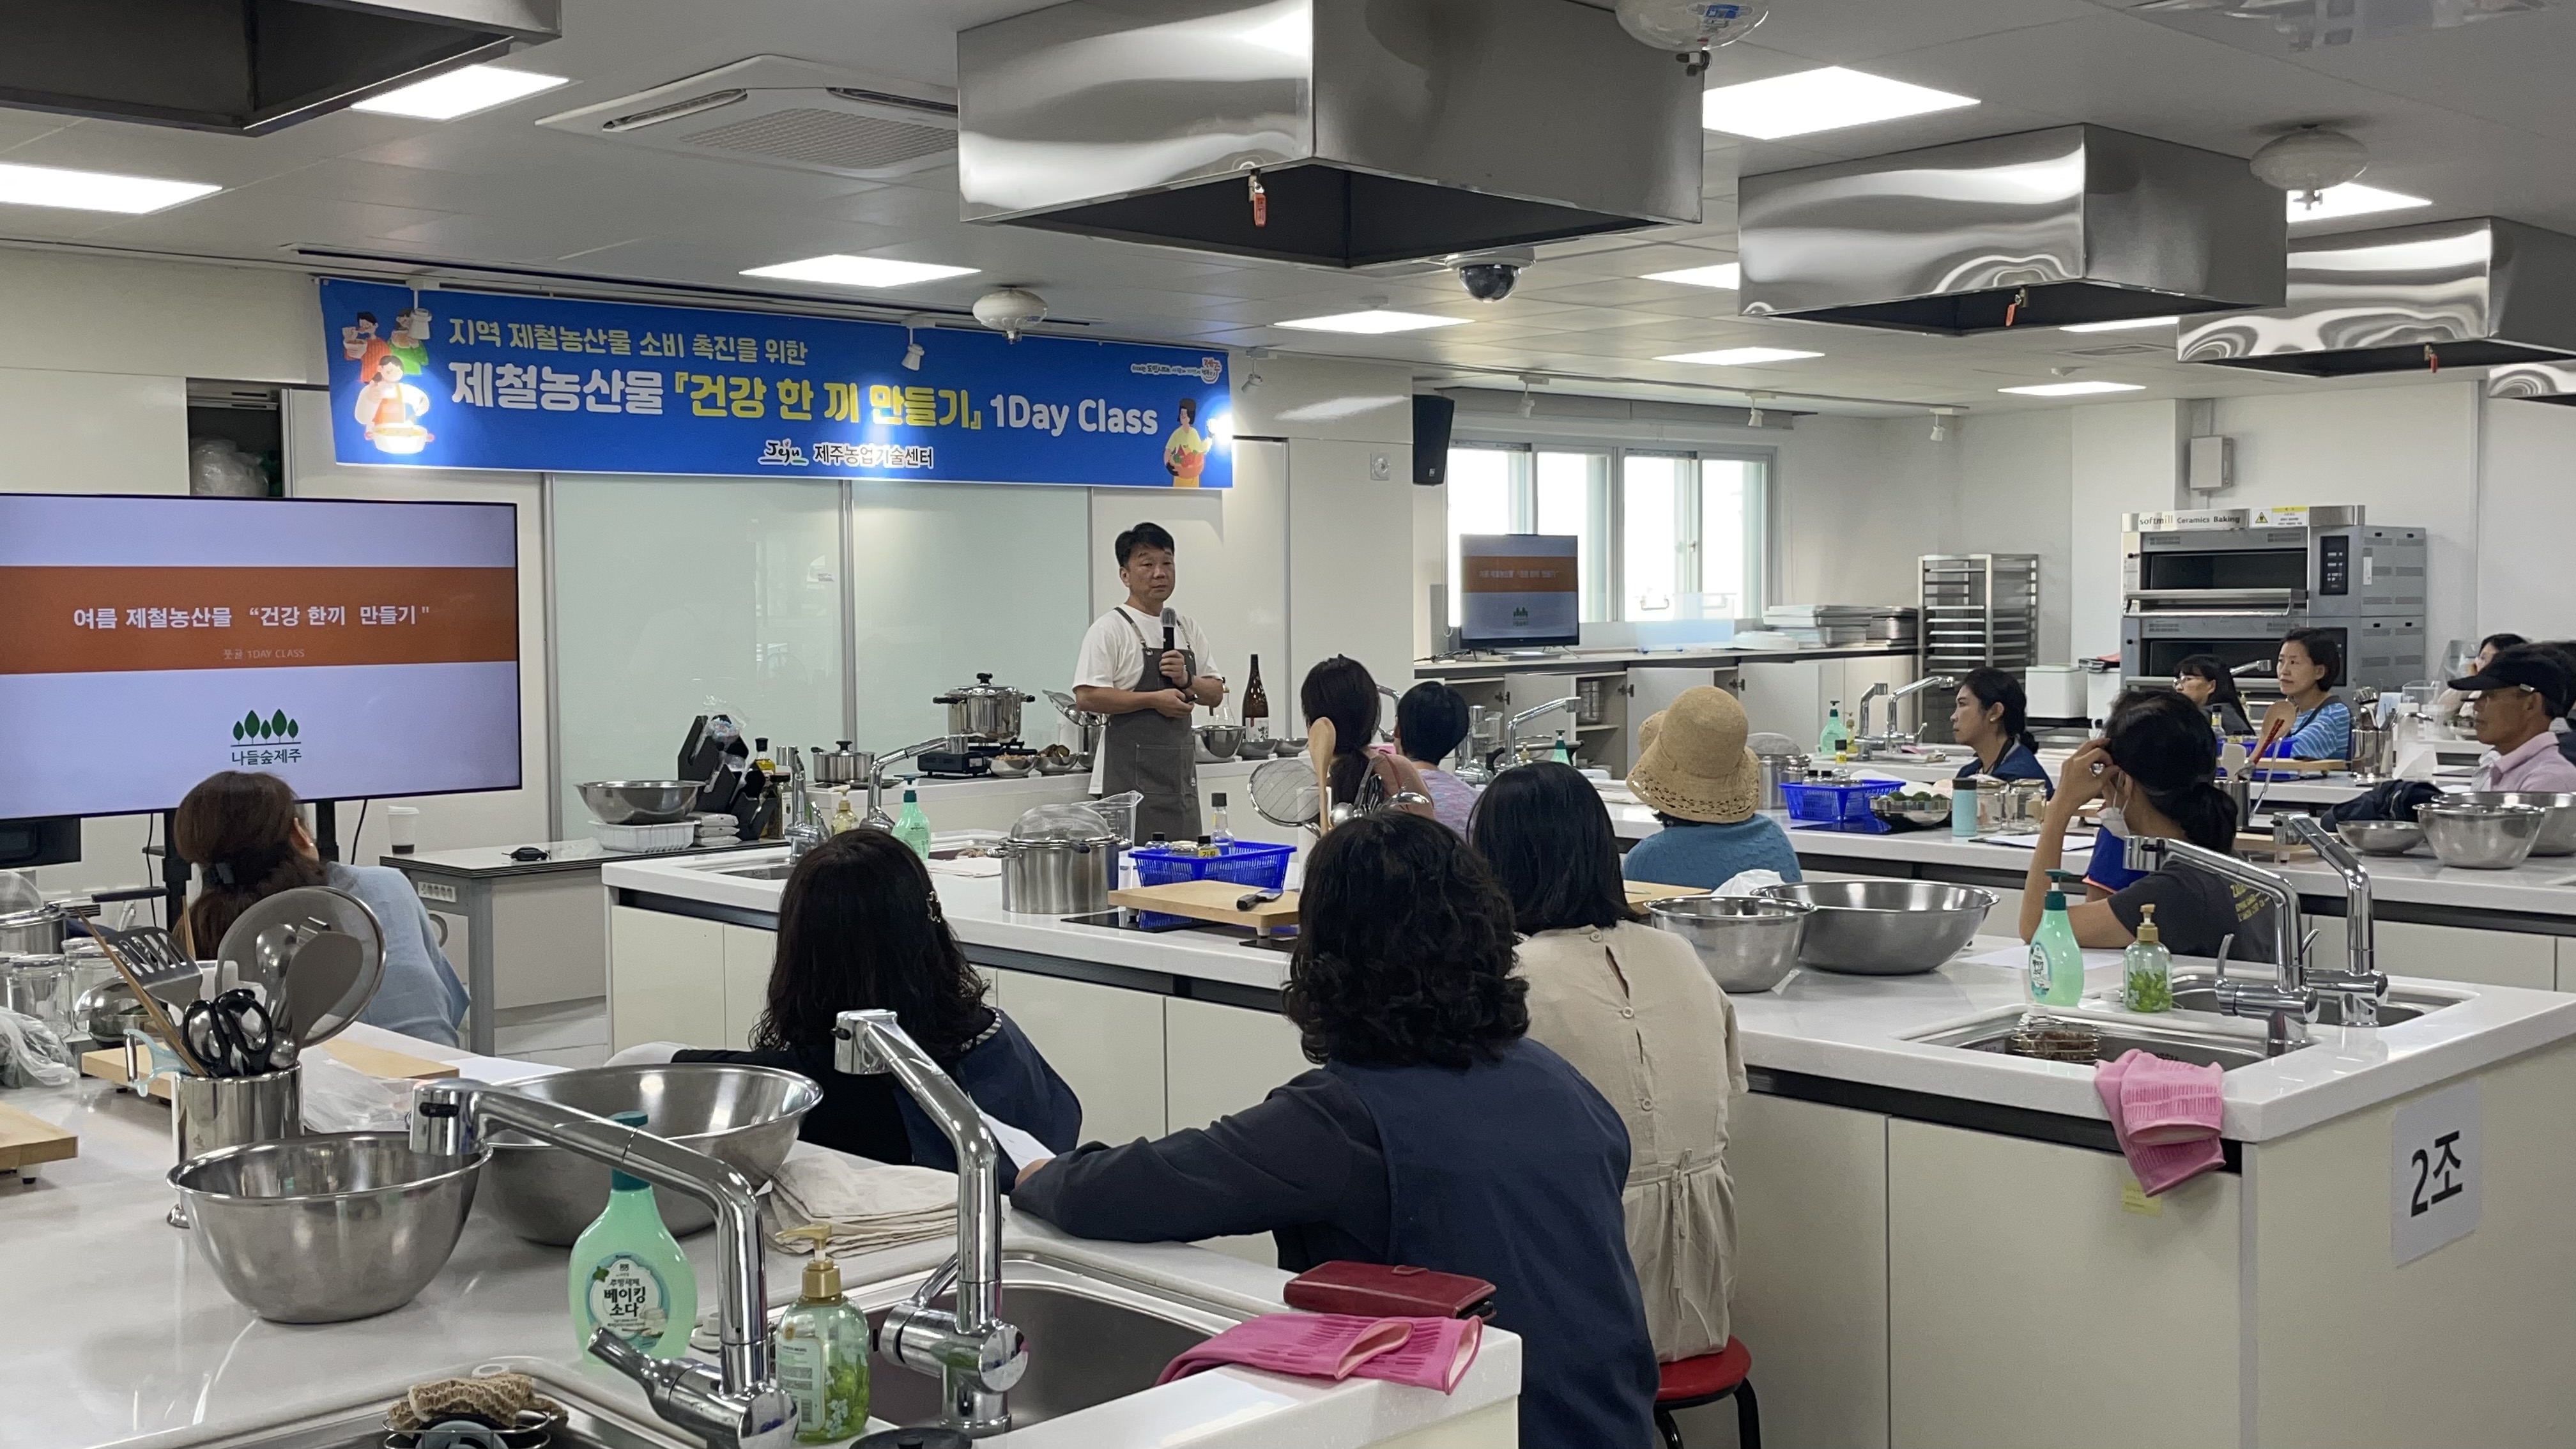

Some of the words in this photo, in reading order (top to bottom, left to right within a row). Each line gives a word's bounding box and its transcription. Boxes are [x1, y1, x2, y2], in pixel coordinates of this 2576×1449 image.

[448, 318, 502, 348] 지역
[507, 323, 632, 356] 제철농산물
[640, 332, 684, 358] 소비
[692, 334, 758, 363] 촉진을
[765, 339, 808, 365] 위한
[448, 361, 664, 415] 제철농산물
[776, 378, 814, 420] 한
[824, 382, 859, 423] 끼
[990, 394, 1070, 437] 1Day
[1078, 398, 1158, 435] Class
[766, 440, 799, 463] Jeju
[815, 444, 933, 467] 제주농업기술센터
[2139, 514, 2174, 525] softmill
[2177, 516, 2210, 524] Ceramics
[2213, 516, 2241, 524] Baking
[73, 608, 118, 629] 여름
[126, 607, 231, 629] 제철농산물
[307, 606, 346, 625] 한끼
[247, 649, 272, 659] 1DAY
[275, 648, 305, 658] CLASS
[231, 748, 302, 766] 나들숲제주
[2411, 1130, 2463, 1217] 2조
[604, 1286, 646, 1303] 베이킹
[610, 1303, 639, 1317] 소다
